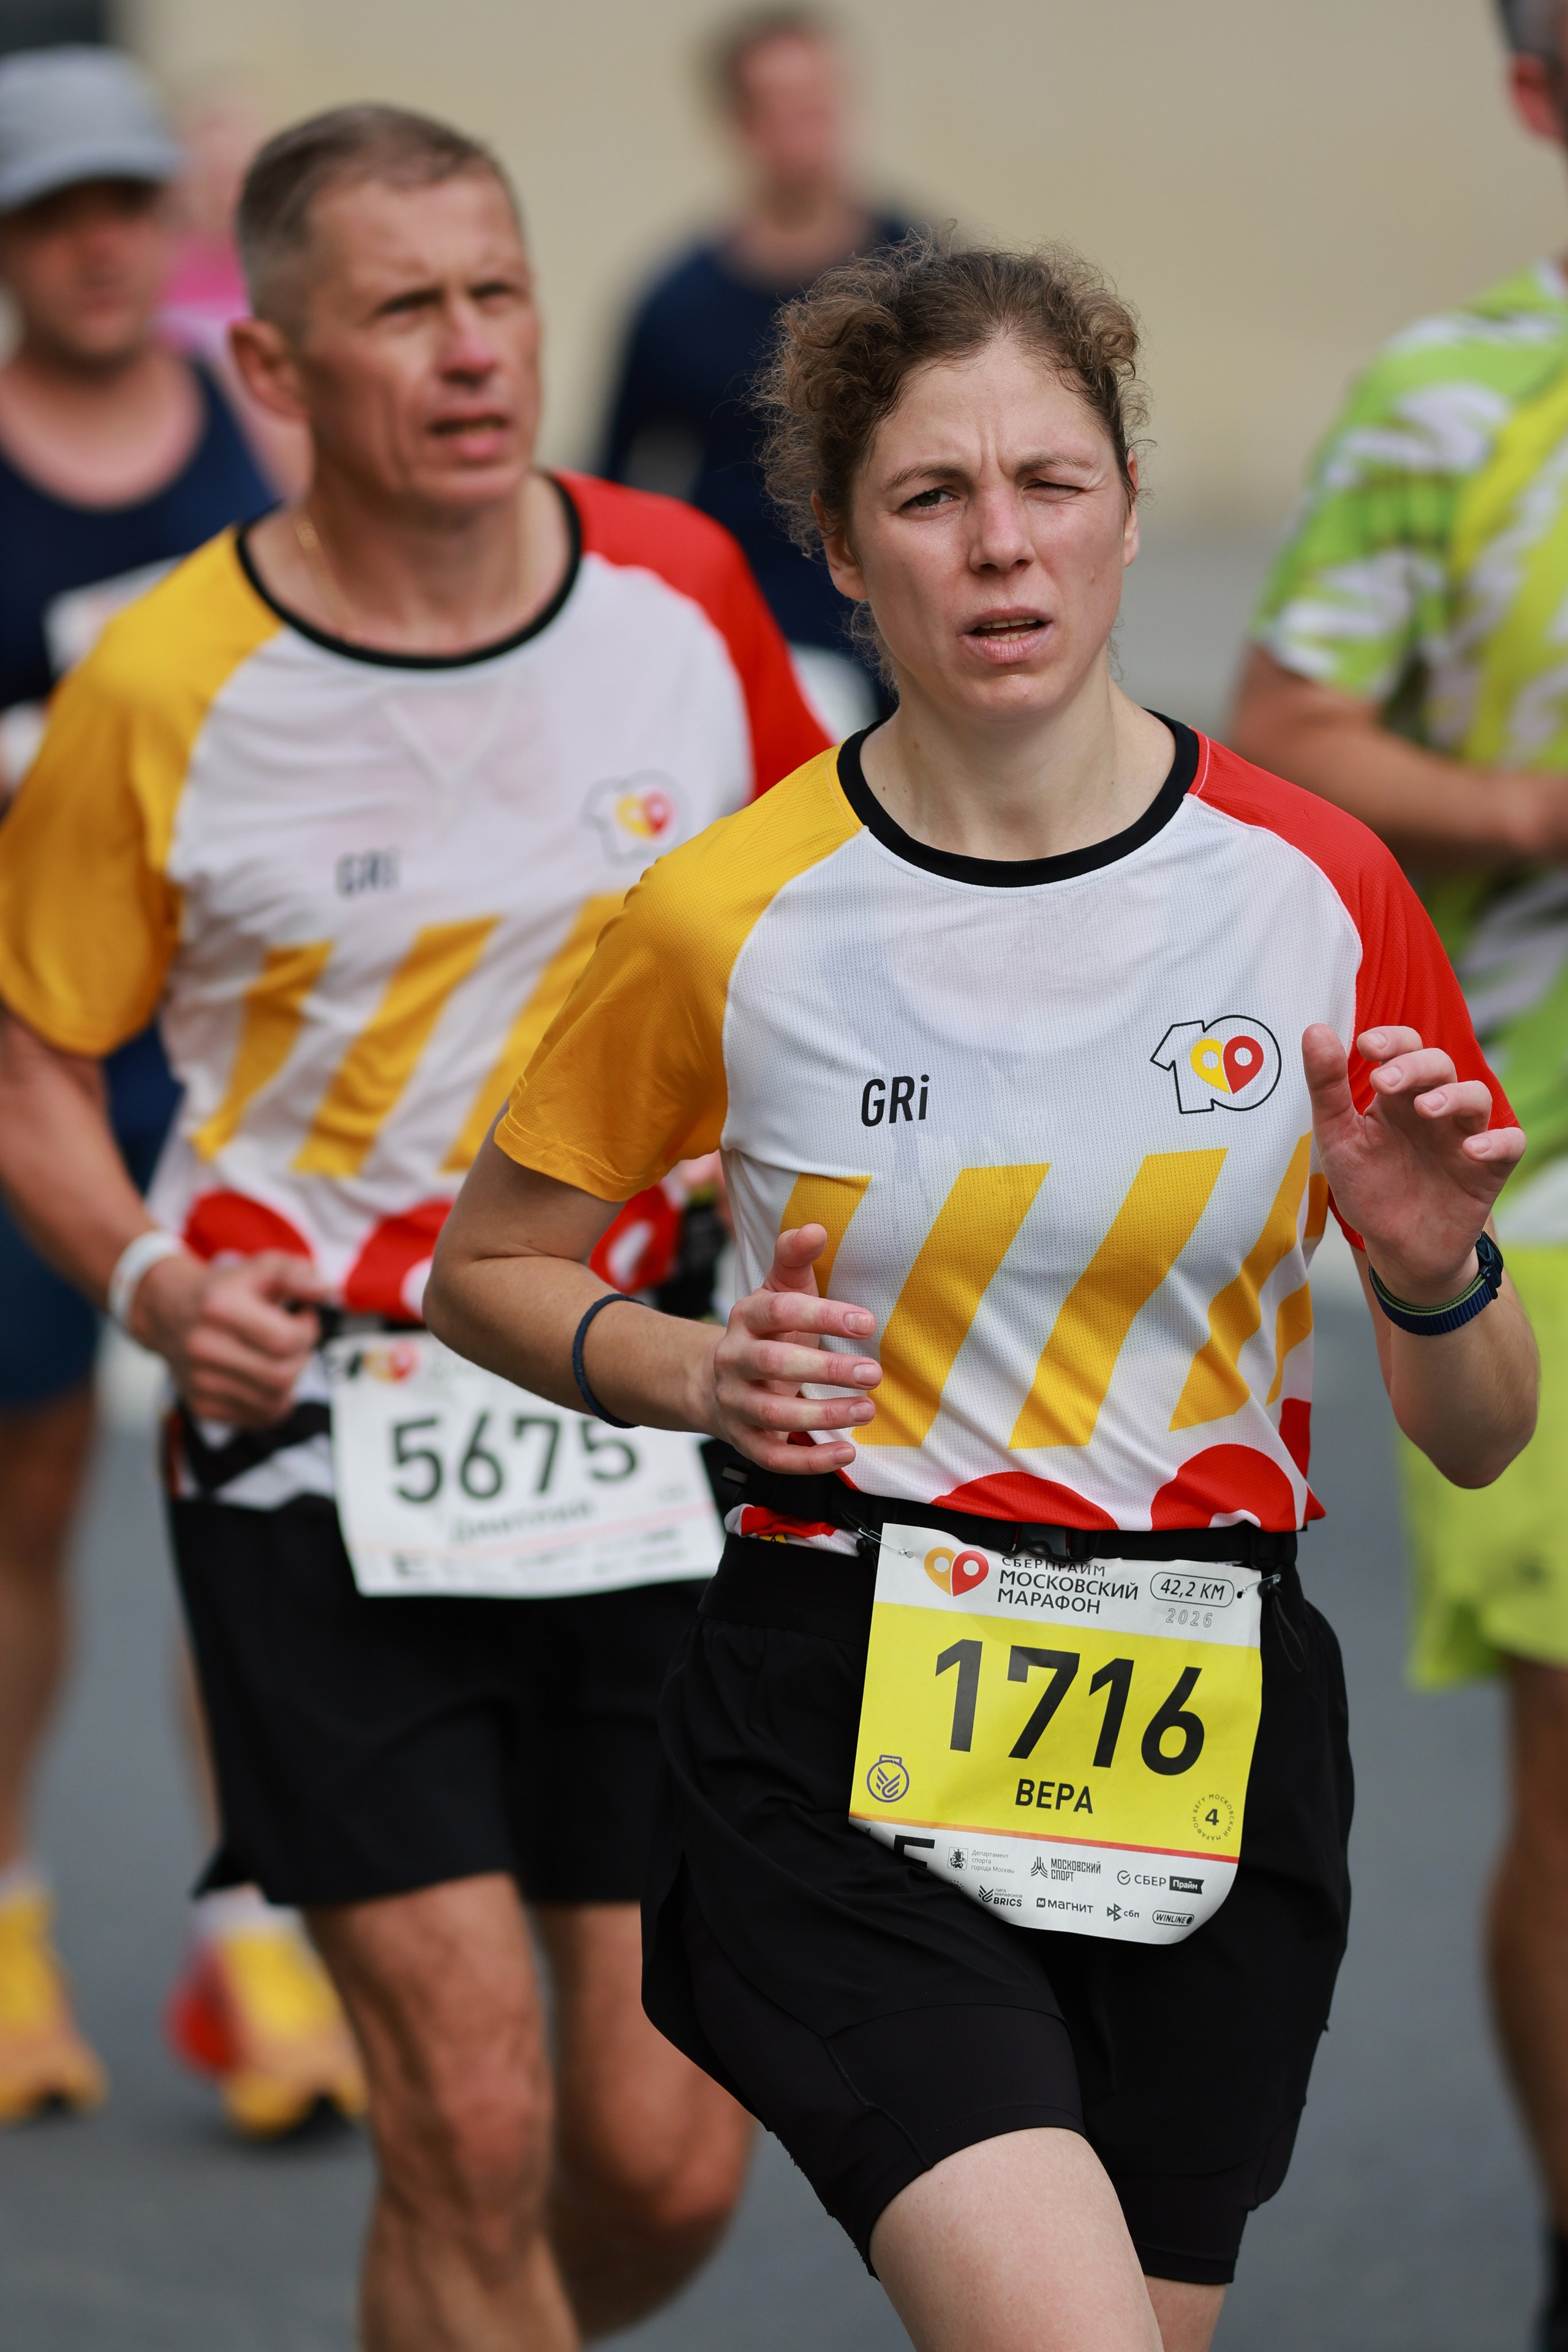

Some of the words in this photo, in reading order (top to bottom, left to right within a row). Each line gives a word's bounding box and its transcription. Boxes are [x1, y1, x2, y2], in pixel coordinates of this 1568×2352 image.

[861, 1074, 930, 1127] GRi
[391, 1412, 638, 1504] 5675
[1000, 1569, 1138, 1600] МОСКОВСКИЙ
[1160, 1578, 1196, 1598] 42,2
[1200, 1583, 1225, 1600] КМ
[997, 1588, 1101, 1615] МАРАФОН
[1166, 1608, 1213, 1627] 2026
[935, 1638, 1205, 1776] 1716
[1015, 1778, 1093, 1814] ВЕРА
[1193, 1796, 1205, 1814] БЕГУ
[1205, 1808, 1219, 1826] 4
[1208, 1793, 1234, 1837] МОСКОВСКИЙ
[1192, 1816, 1221, 1841] МАРАФОН
[971, 1850, 1009, 1858] Департамент
[1050, 1858, 1101, 1874] МОСКОВСКИЙ
[1051, 1869, 1074, 1882] СПОРТ
[1134, 1874, 1167, 1887] СБЕР
[1172, 1879, 1198, 1890] Прайм
[993, 1897, 1022, 1907] BRICS
[1047, 1899, 1094, 1913] магнит
[1156, 1913, 1187, 1924] WINLINE
